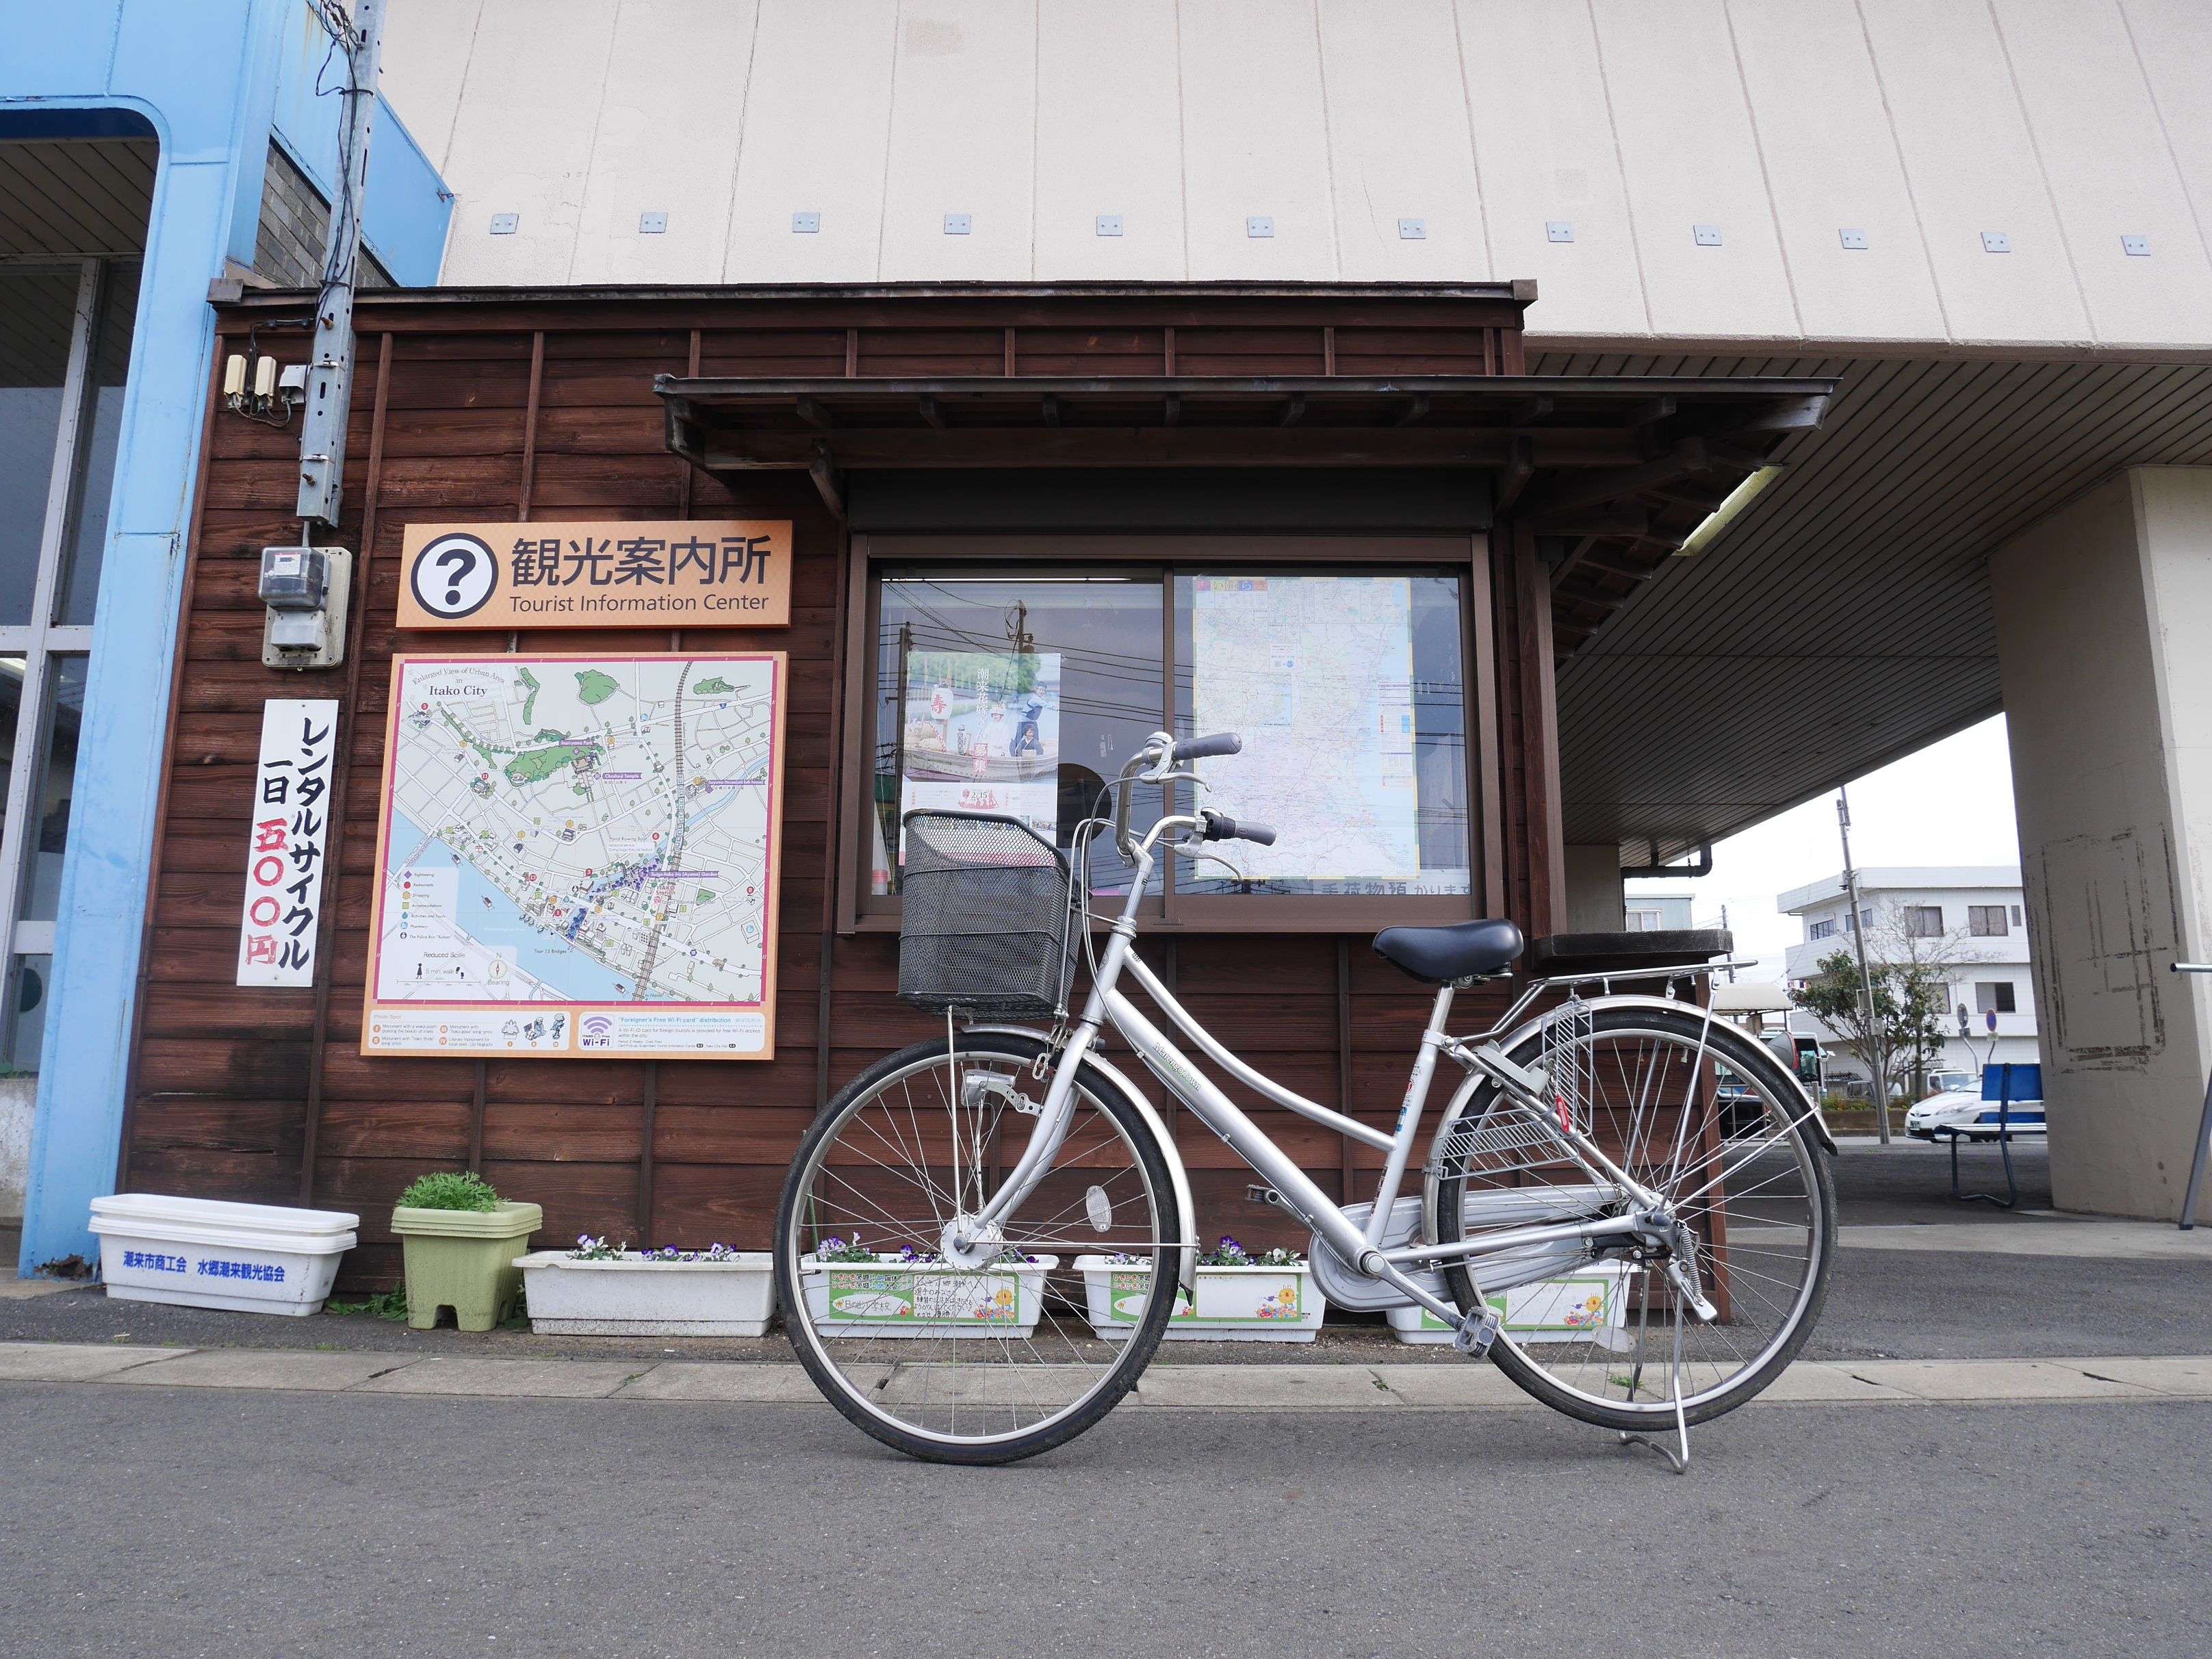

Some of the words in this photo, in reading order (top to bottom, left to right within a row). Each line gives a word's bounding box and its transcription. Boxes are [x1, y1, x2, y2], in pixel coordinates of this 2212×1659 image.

[511, 535, 771, 587] 観光案内所
[509, 595, 574, 612] Tourist
[581, 594, 696, 610] Information
[704, 594, 769, 610] Center
[413, 669, 442, 684] Enlarged
[469, 668, 489, 678] Urban
[491, 673, 505, 684] Area
[429, 686, 460, 695] Itako
[463, 686, 488, 697] City
[931, 694, 947, 715] 寿
[974, 668, 990, 772] 潮来花嫁さん募集
[970, 791, 988, 799] 2/15
[278, 717, 329, 970] レンタルサイクル
[582, 1038, 610, 1046] Wi-Fi
[1152, 1042, 1202, 1092] MarengoTown
[123, 1250, 187, 1273] 潮来市商工会
[196, 1259, 285, 1283] 水郷潮来観光協会
